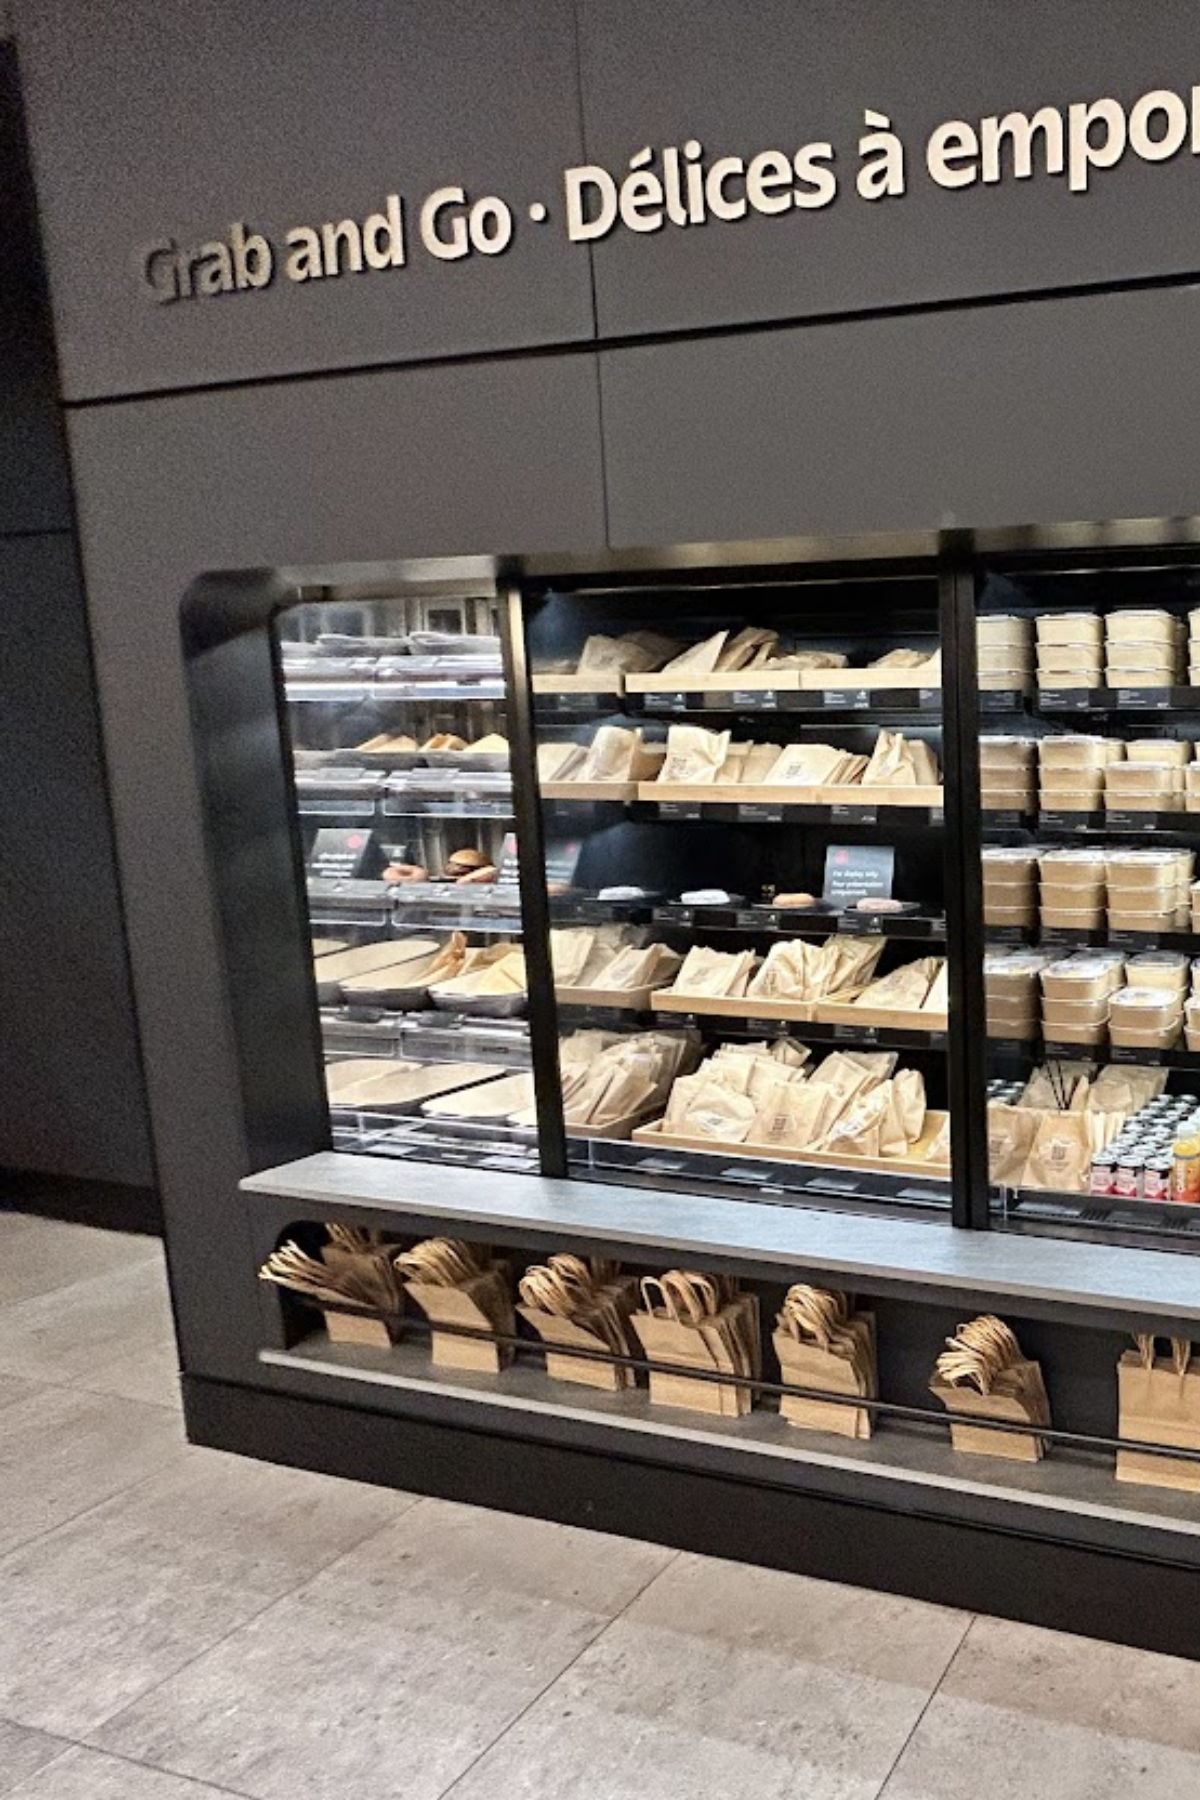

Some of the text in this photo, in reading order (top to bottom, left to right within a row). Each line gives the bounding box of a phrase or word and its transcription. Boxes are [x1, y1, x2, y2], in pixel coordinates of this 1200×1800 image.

[142, 222, 273, 307] Grab
[286, 195, 404, 283] and
[420, 186, 511, 262] Go
[565, 140, 837, 243] Délices
[856, 110, 904, 201] à
